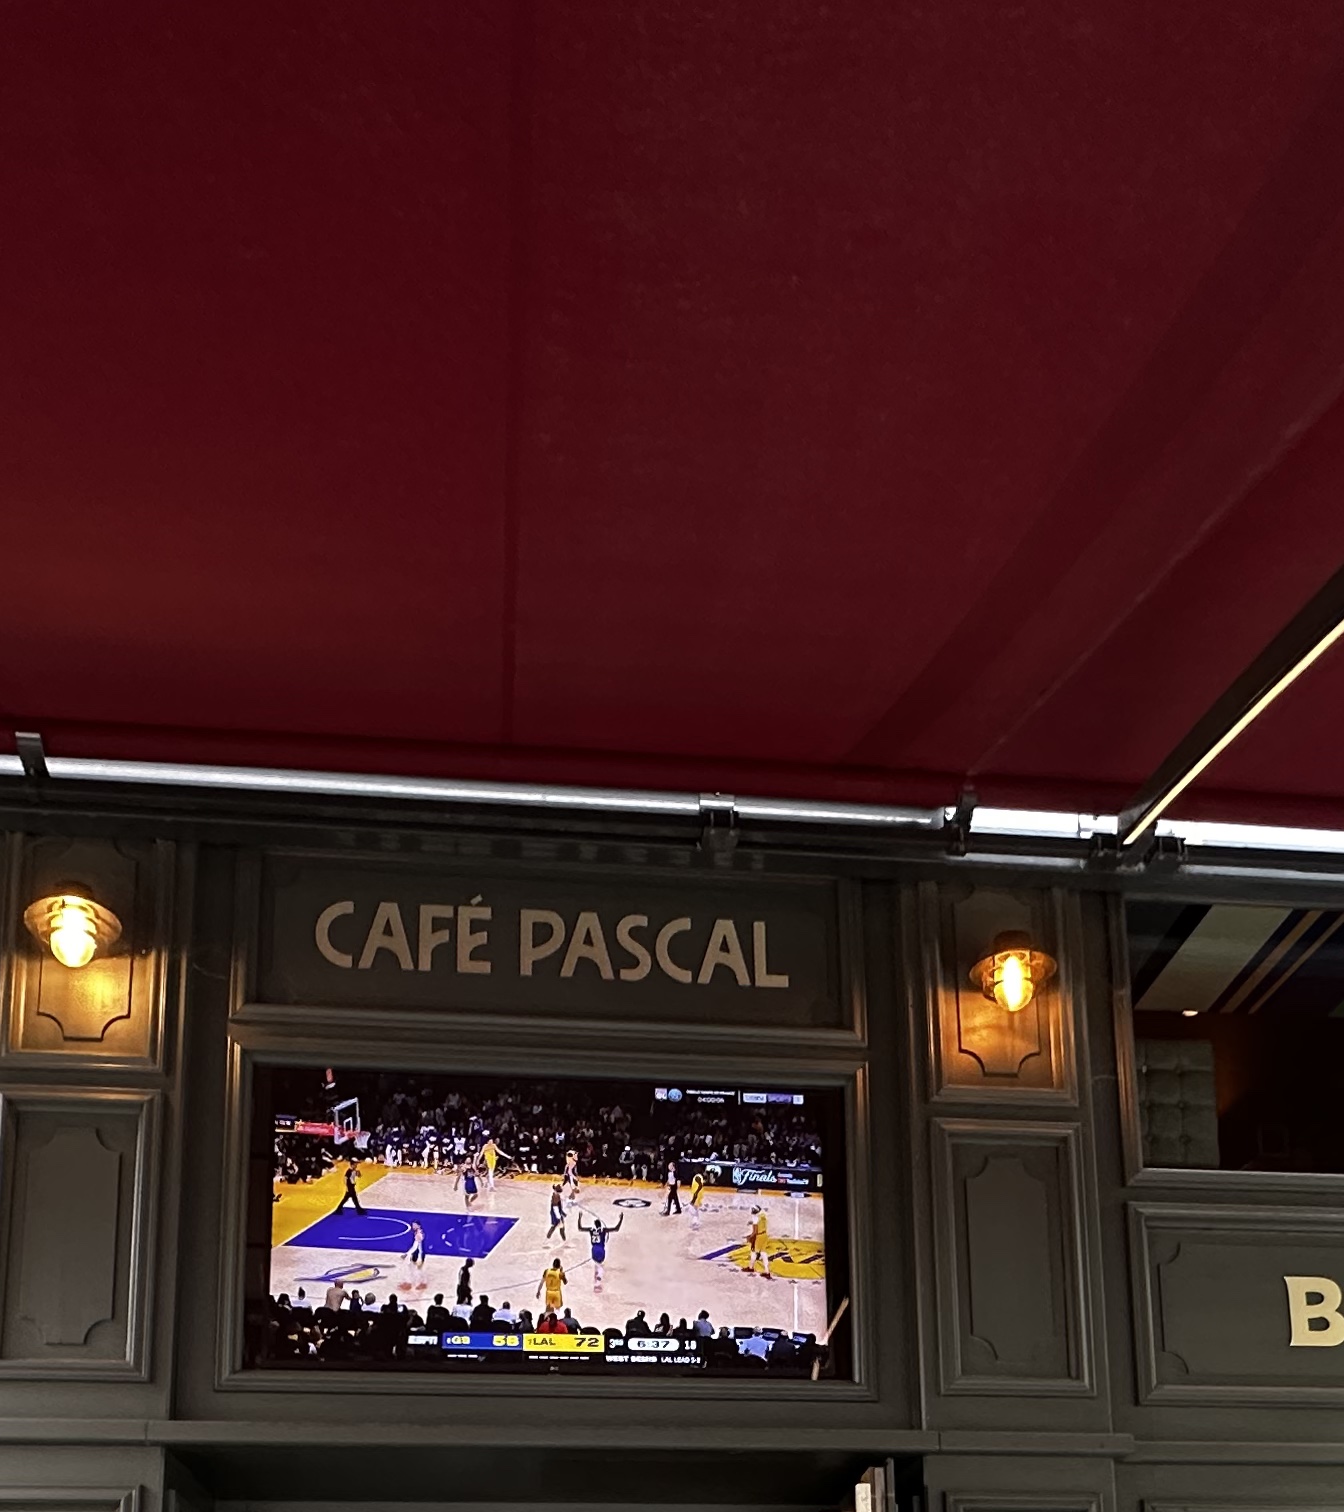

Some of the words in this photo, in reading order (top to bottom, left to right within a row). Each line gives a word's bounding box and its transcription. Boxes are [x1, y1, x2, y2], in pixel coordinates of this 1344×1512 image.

[315, 895, 492, 974] CAFÉ
[520, 908, 790, 988] PASCAL
[533, 1338, 557, 1346] LAL
[574, 1337, 600, 1348] 72
